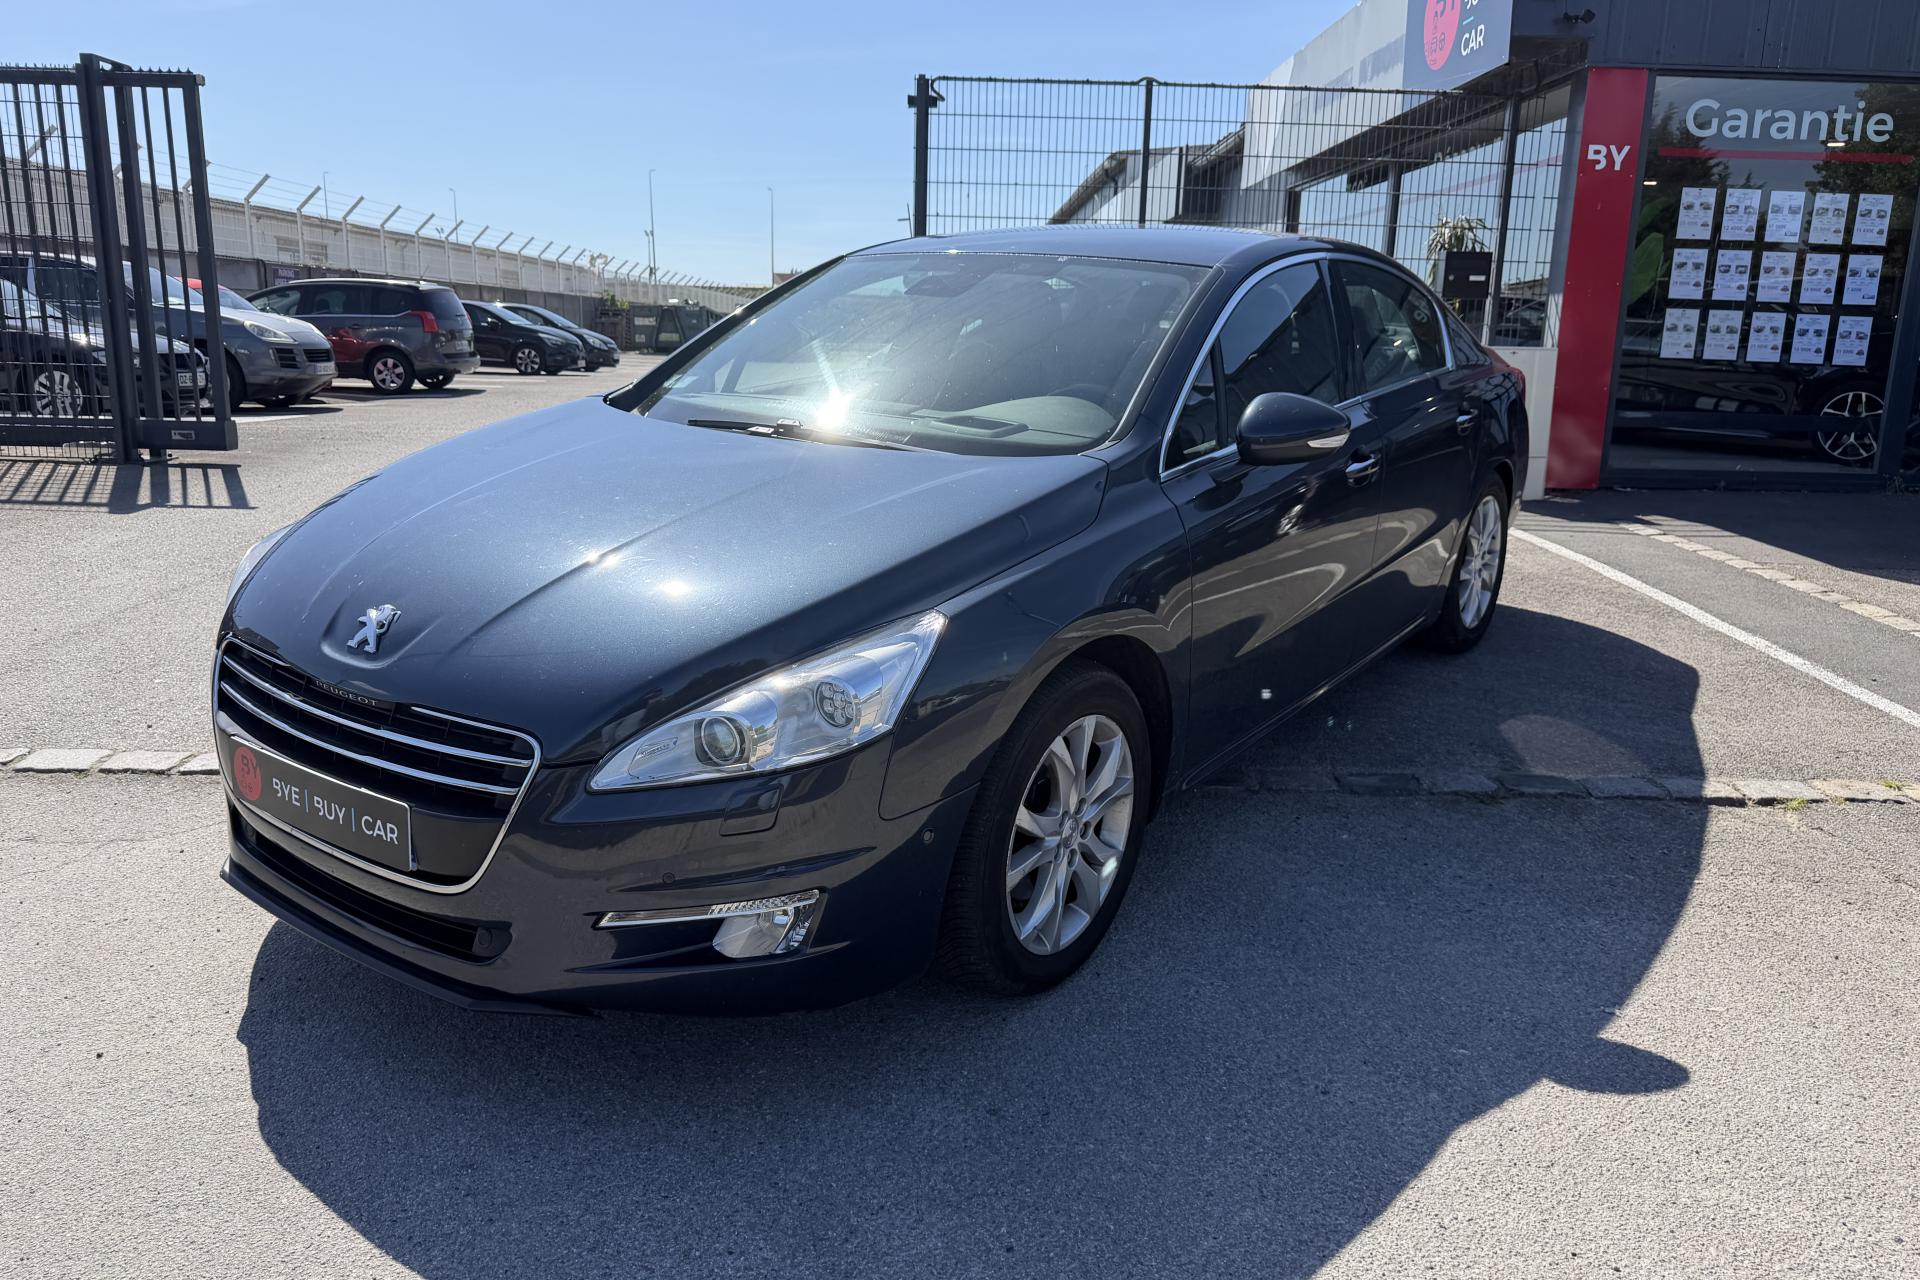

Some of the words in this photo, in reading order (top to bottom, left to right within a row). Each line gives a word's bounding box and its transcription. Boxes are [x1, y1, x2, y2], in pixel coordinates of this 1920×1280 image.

[1460, 24, 1485, 56] CAR
[1685, 99, 1894, 143] Garantie
[1587, 144, 1631, 171] BY
[316, 681, 377, 706] PEUGEOT
[272, 777, 301, 807] BYE
[313, 796, 346, 825] BUY
[361, 816, 399, 844] CAR
